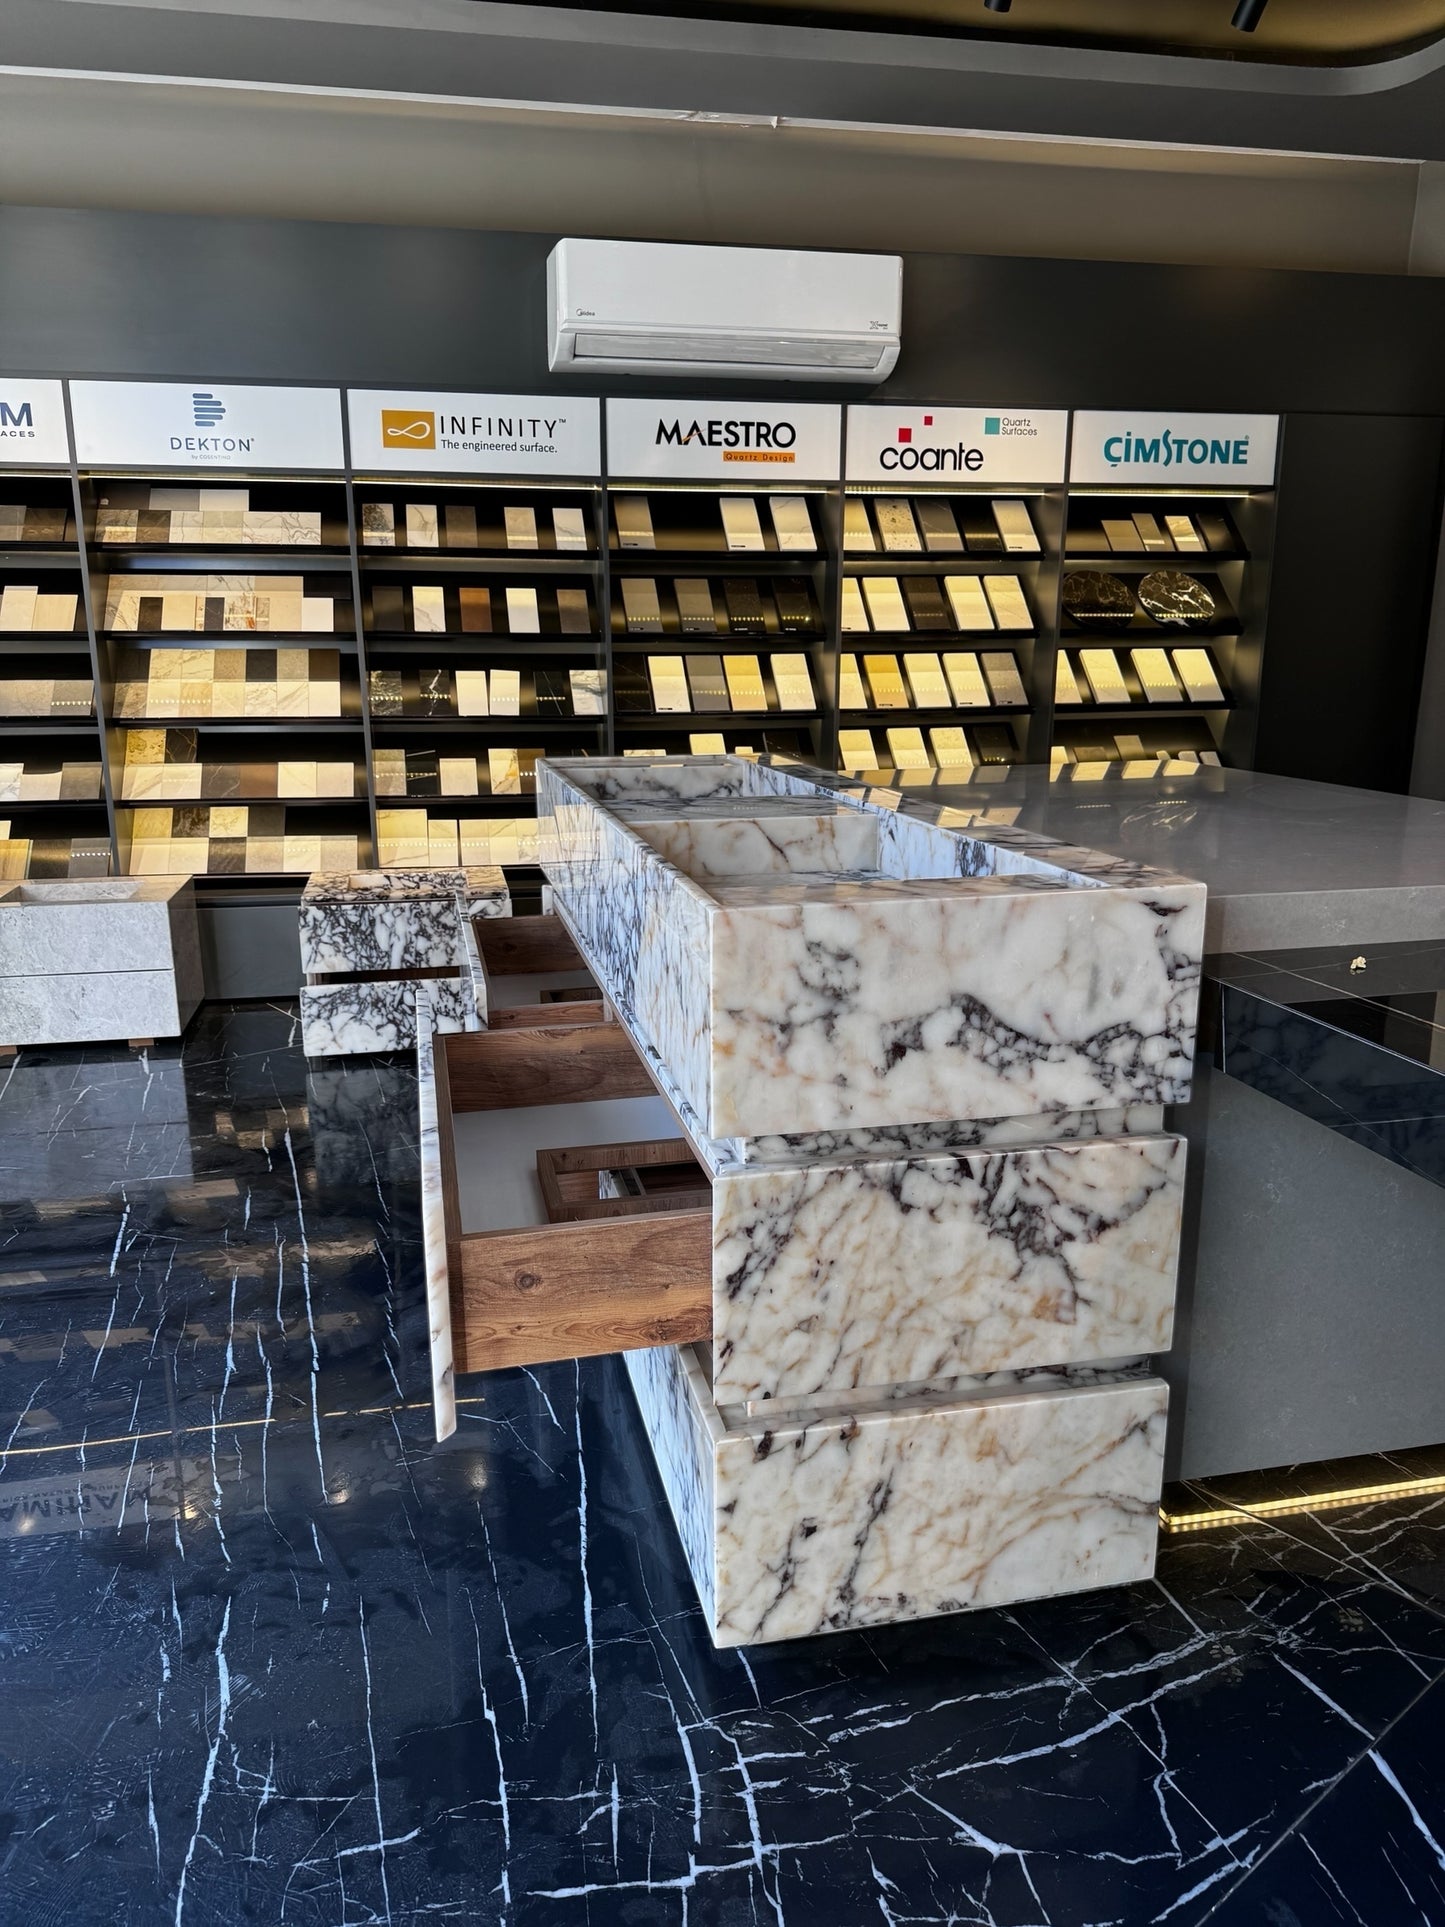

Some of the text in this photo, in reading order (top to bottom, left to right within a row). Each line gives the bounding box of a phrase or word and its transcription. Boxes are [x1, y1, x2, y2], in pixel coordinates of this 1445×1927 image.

[1002, 418, 1031, 427] Quartz
[655, 419, 796, 449] MAESTRO
[1002, 426, 1038, 436] Surfaces
[441, 439, 558, 454] The engineered surface.
[726, 453, 793, 463] Quartz Design
[880, 442, 984, 471] coante
